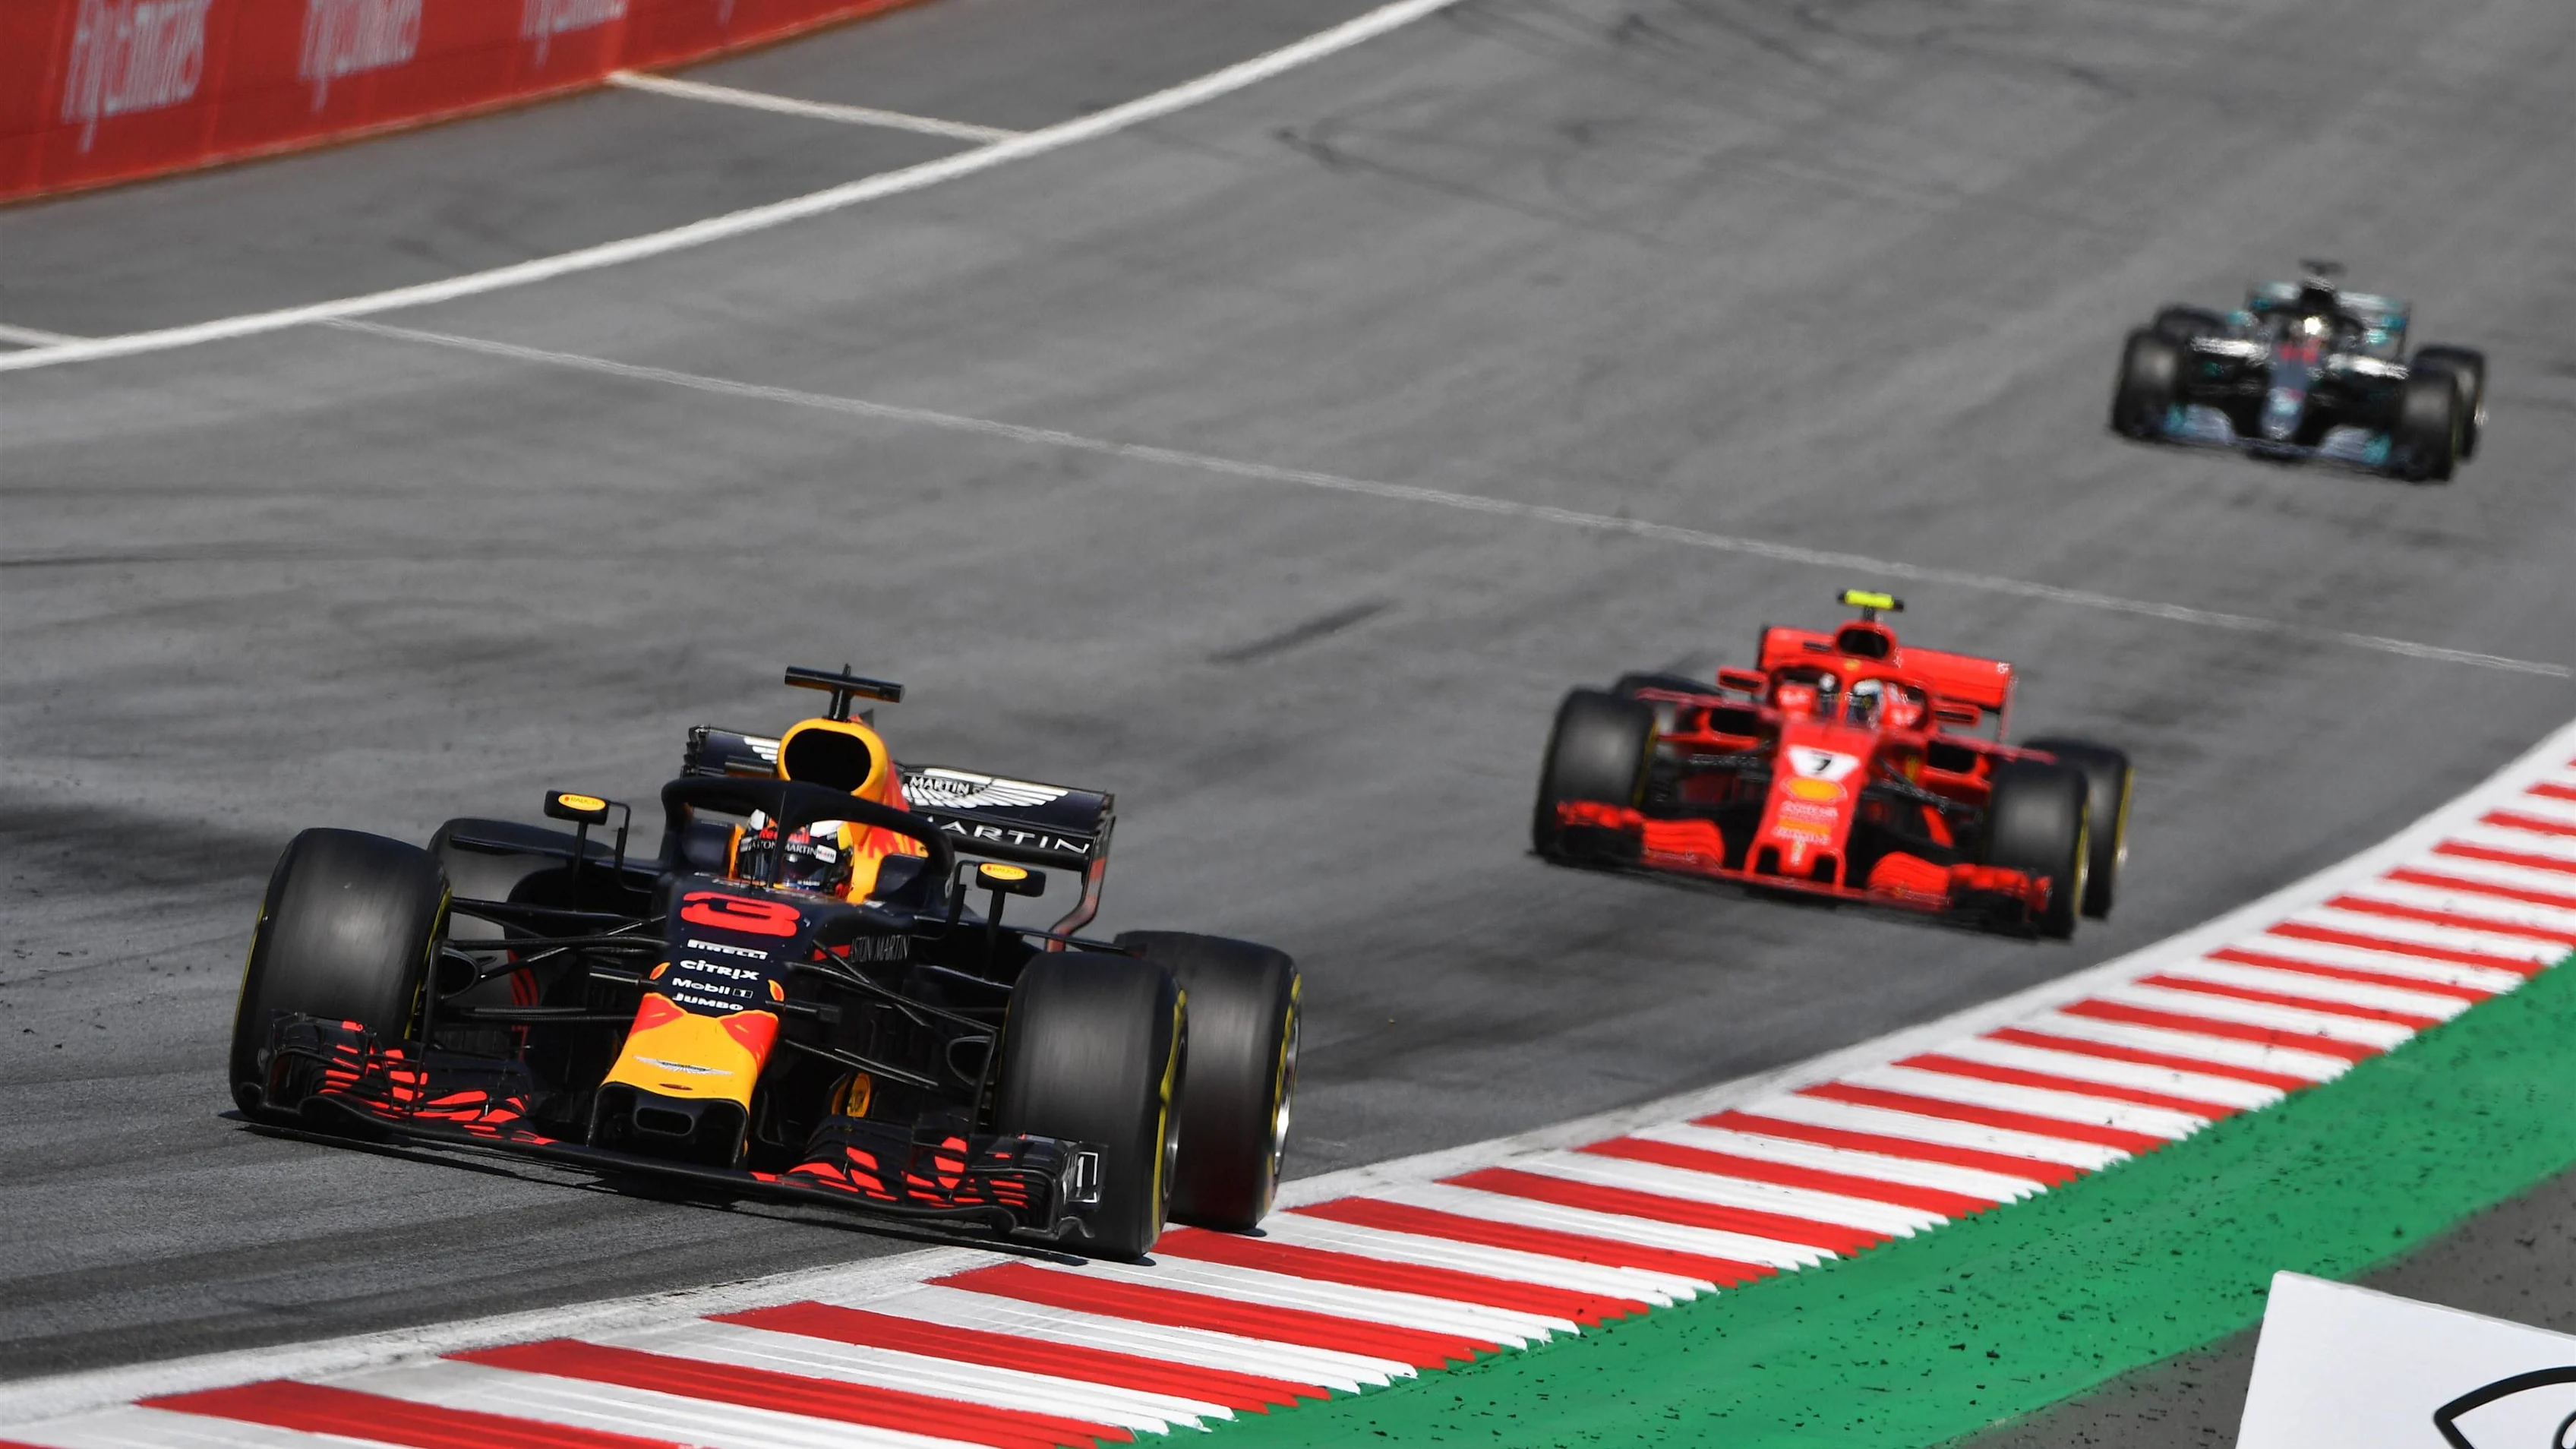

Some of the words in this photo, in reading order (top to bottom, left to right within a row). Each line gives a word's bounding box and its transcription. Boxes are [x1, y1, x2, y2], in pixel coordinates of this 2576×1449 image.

[1810, 752, 1833, 773] 7
[911, 775, 971, 795] MARTIN
[928, 815, 1090, 854] ARTIN
[680, 891, 800, 937] 3
[687, 939, 769, 960] PIRELLI
[671, 977, 731, 995] Mobil
[671, 993, 744, 1012] JUMBO
